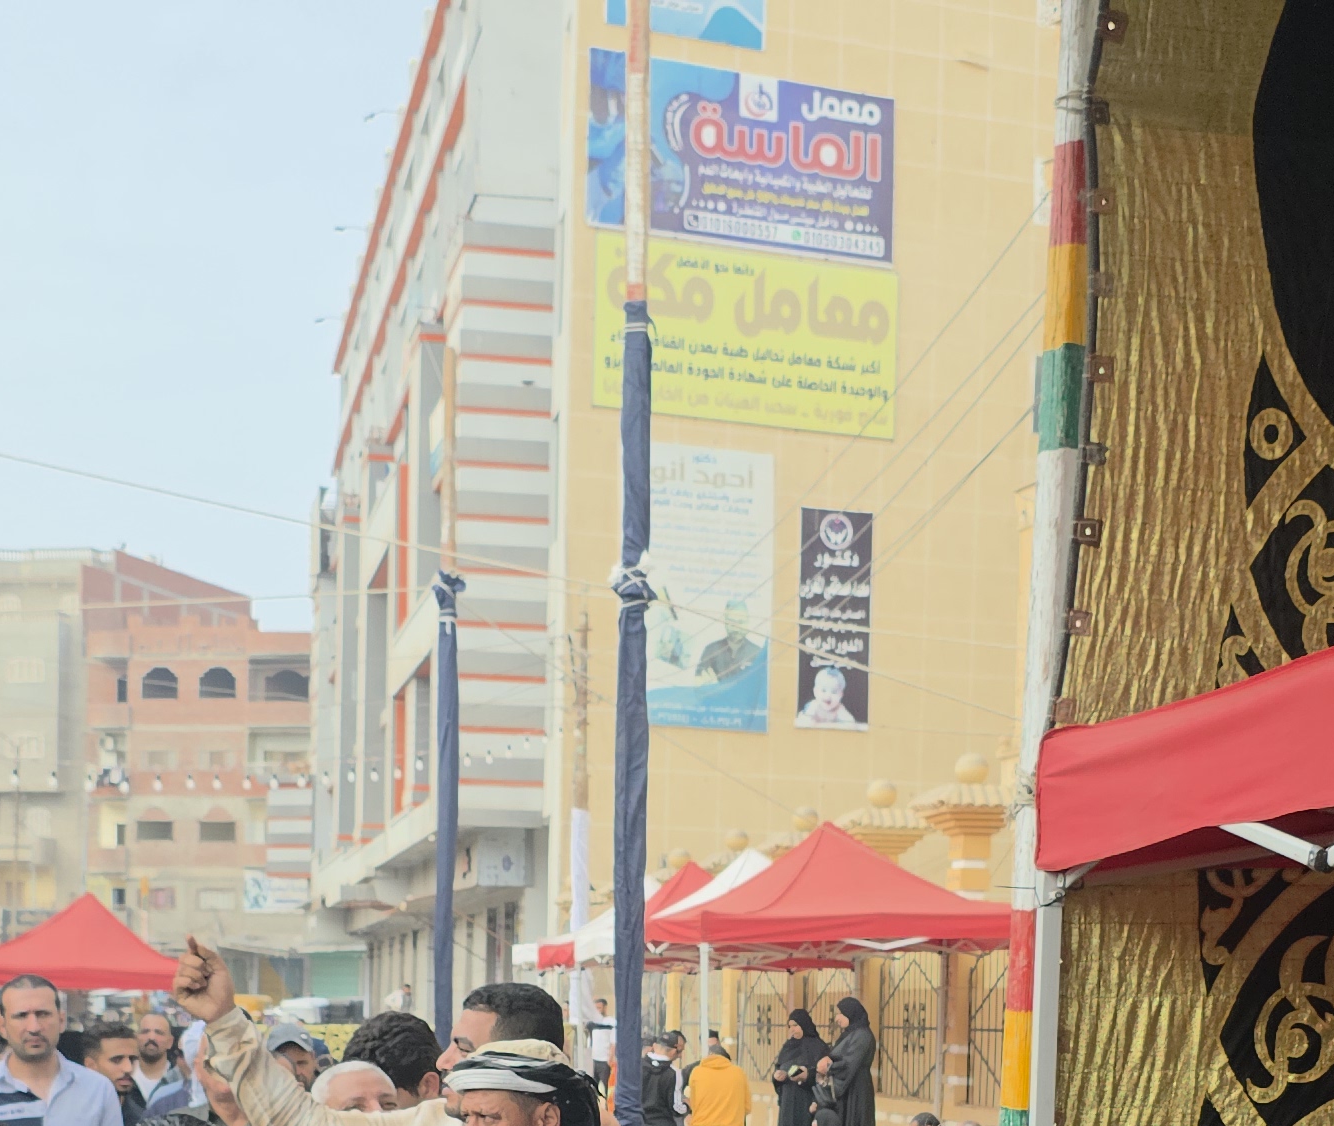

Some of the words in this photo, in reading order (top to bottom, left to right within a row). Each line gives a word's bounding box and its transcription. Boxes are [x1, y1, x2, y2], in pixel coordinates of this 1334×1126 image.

[800, 90, 882, 126] معمل
[689, 101, 883, 183] الماسة
[714, 262, 729, 275] نحو
[606, 246, 714, 323] مكة
[734, 267, 890, 345] معامل
[722, 343, 749, 359] طبية
[752, 347, 785, 363] تحاليل
[788, 350, 822, 368] معامل
[651, 358, 683, 375] العالم
[826, 355, 856, 372] شبكة
[687, 364, 724, 381] الجودة
[728, 369, 767, 385] شهادة
[771, 373, 793, 388] على
[796, 377, 837, 394] الحاصلة
[840, 384, 889, 403] والوحيدة
[651, 456, 685, 484] أنو
[813, 549, 860, 569] دكتور
[835, 637, 864, 655] الدور
